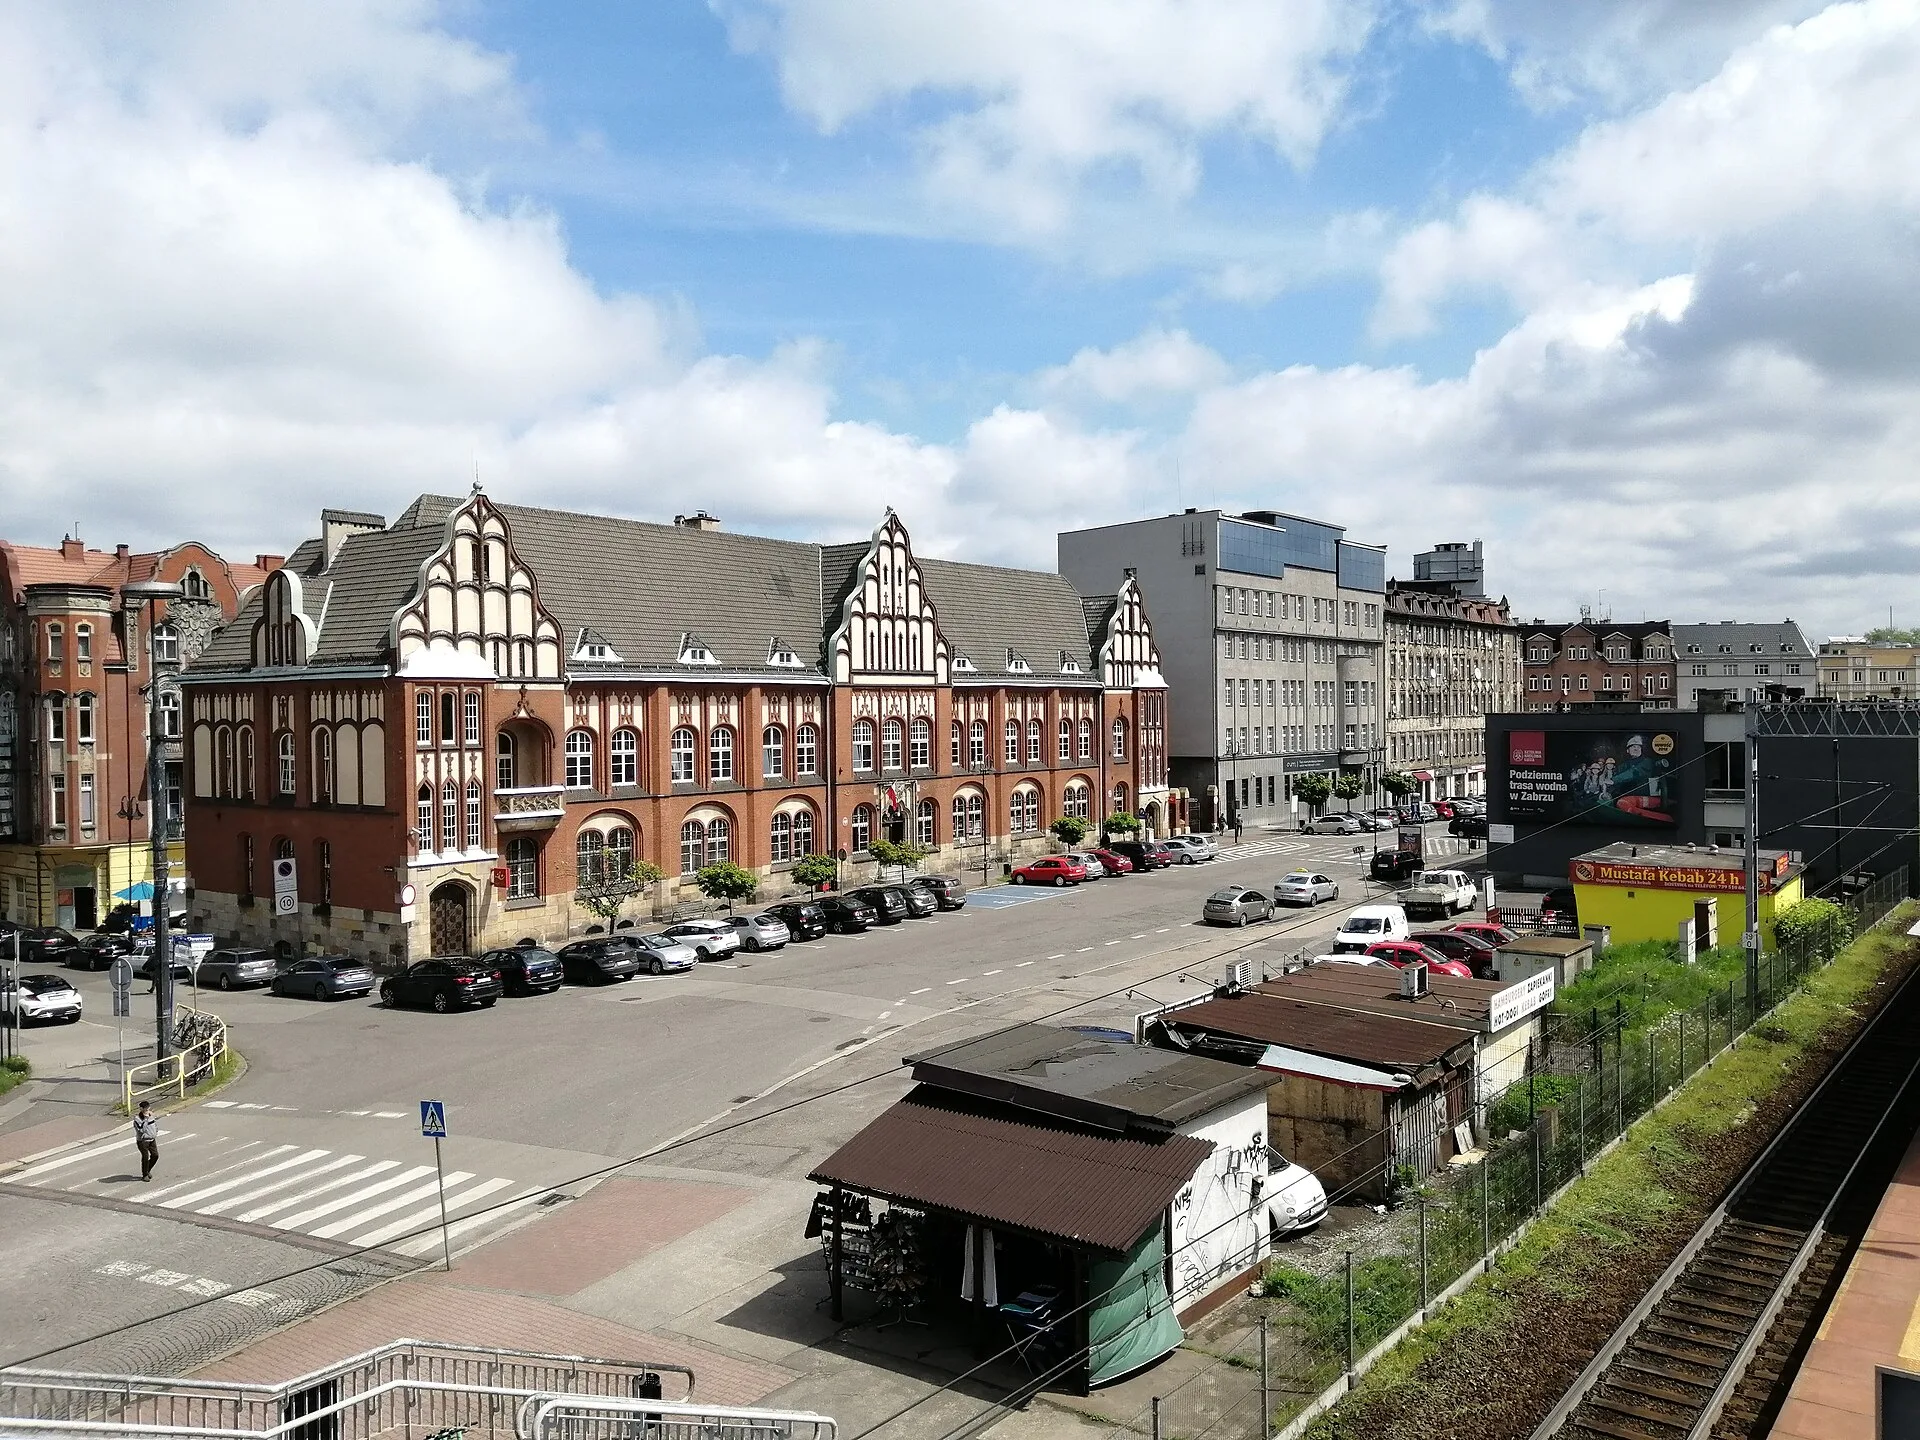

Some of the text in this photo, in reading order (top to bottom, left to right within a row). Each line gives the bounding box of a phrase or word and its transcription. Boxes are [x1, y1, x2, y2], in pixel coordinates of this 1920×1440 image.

[1509, 769, 1563, 780] Podziemna
[1509, 780, 1568, 792] trasa wodna
[1509, 791, 1555, 802] w Zabrzu
[1600, 867, 1656, 881] Mustafa
[1659, 870, 1705, 884] Kebab
[1708, 872, 1726, 884] 24
[1730, 873, 1739, 885] h
[282, 898, 292, 907] 10
[1527, 971, 1553, 993] ZAPIEKANKI
[1493, 1005, 1519, 1027] HOT-DOGI
[1538, 987, 1552, 1003] GOFRY
